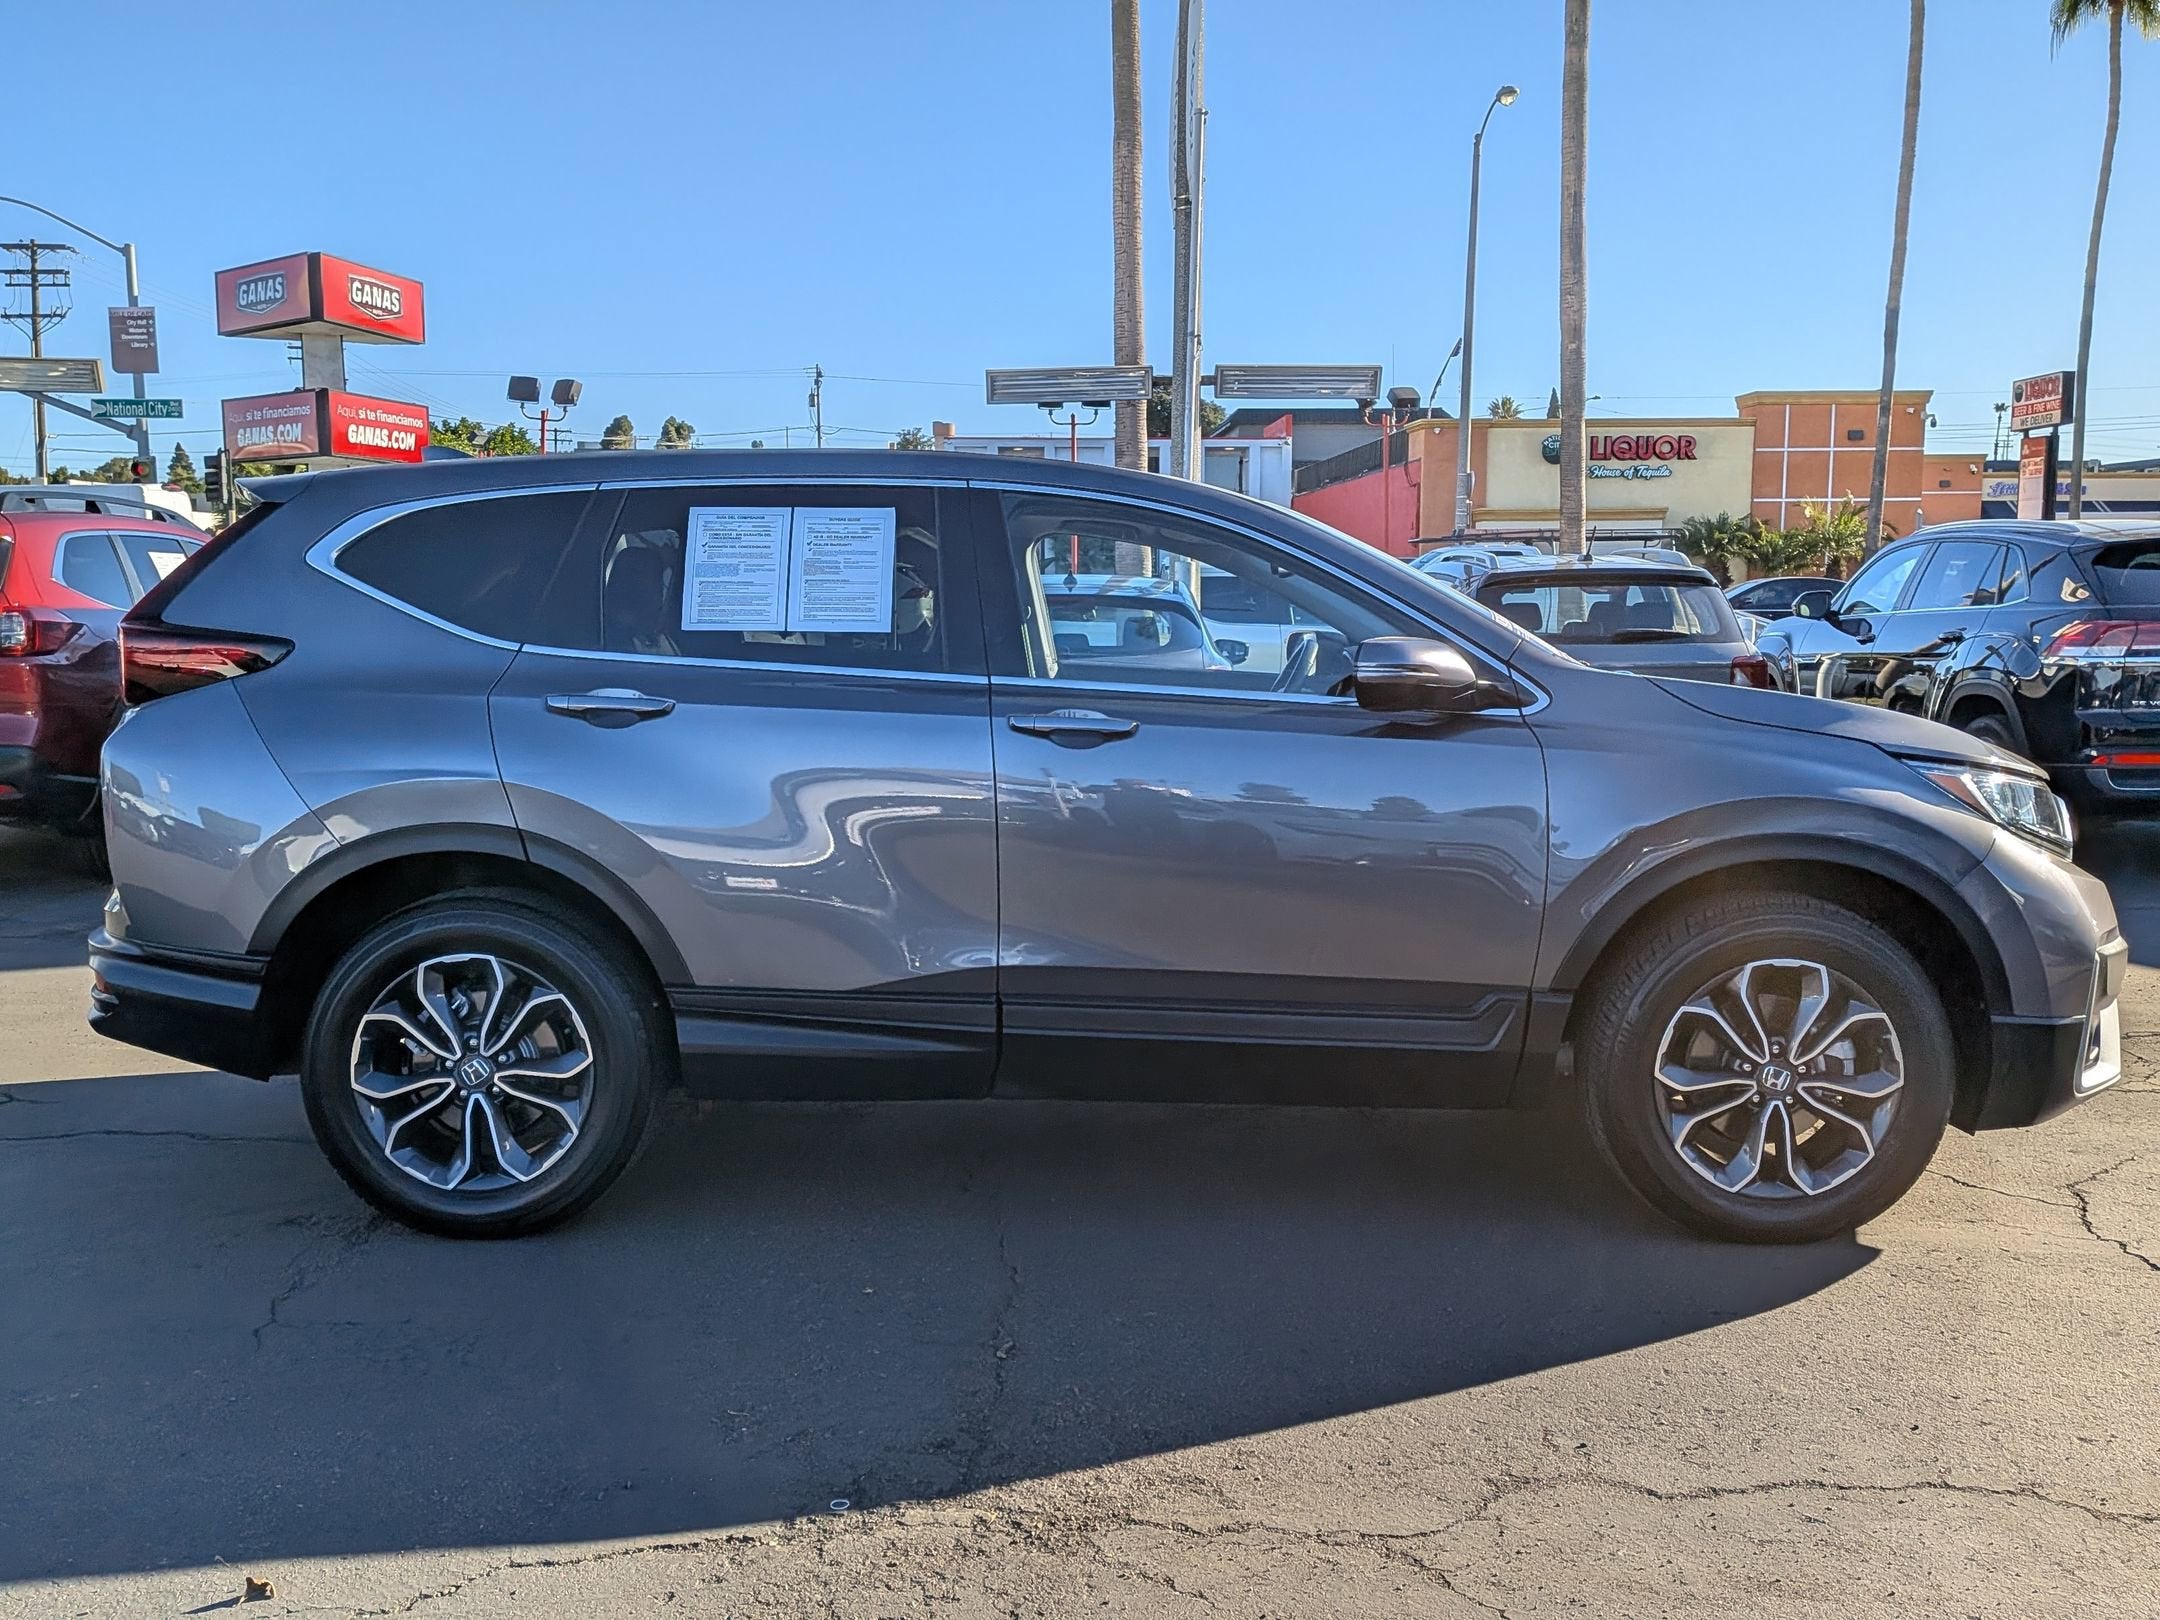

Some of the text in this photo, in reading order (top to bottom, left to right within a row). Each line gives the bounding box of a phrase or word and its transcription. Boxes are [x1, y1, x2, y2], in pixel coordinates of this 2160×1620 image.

[239, 277, 282, 305] GANAS
[352, 280, 400, 312] GANAS
[2025, 375, 2060, 402] LIQUOR
[106, 401, 168, 417] National City
[253, 410, 262, 419] te
[263, 404, 311, 418] financiamos
[366, 409, 376, 421] te
[376, 409, 424, 428] financiamos
[2013, 399, 2061, 417] BEER & FINE WINE
[2020, 413, 2053, 427] WE DELIVER
[237, 423, 302, 447] GANAS.COM
[347, 424, 416, 452] GANAS.COM
[1590, 435, 1698, 461] LIQUOR
[1589, 464, 1672, 480] House of Tequila
